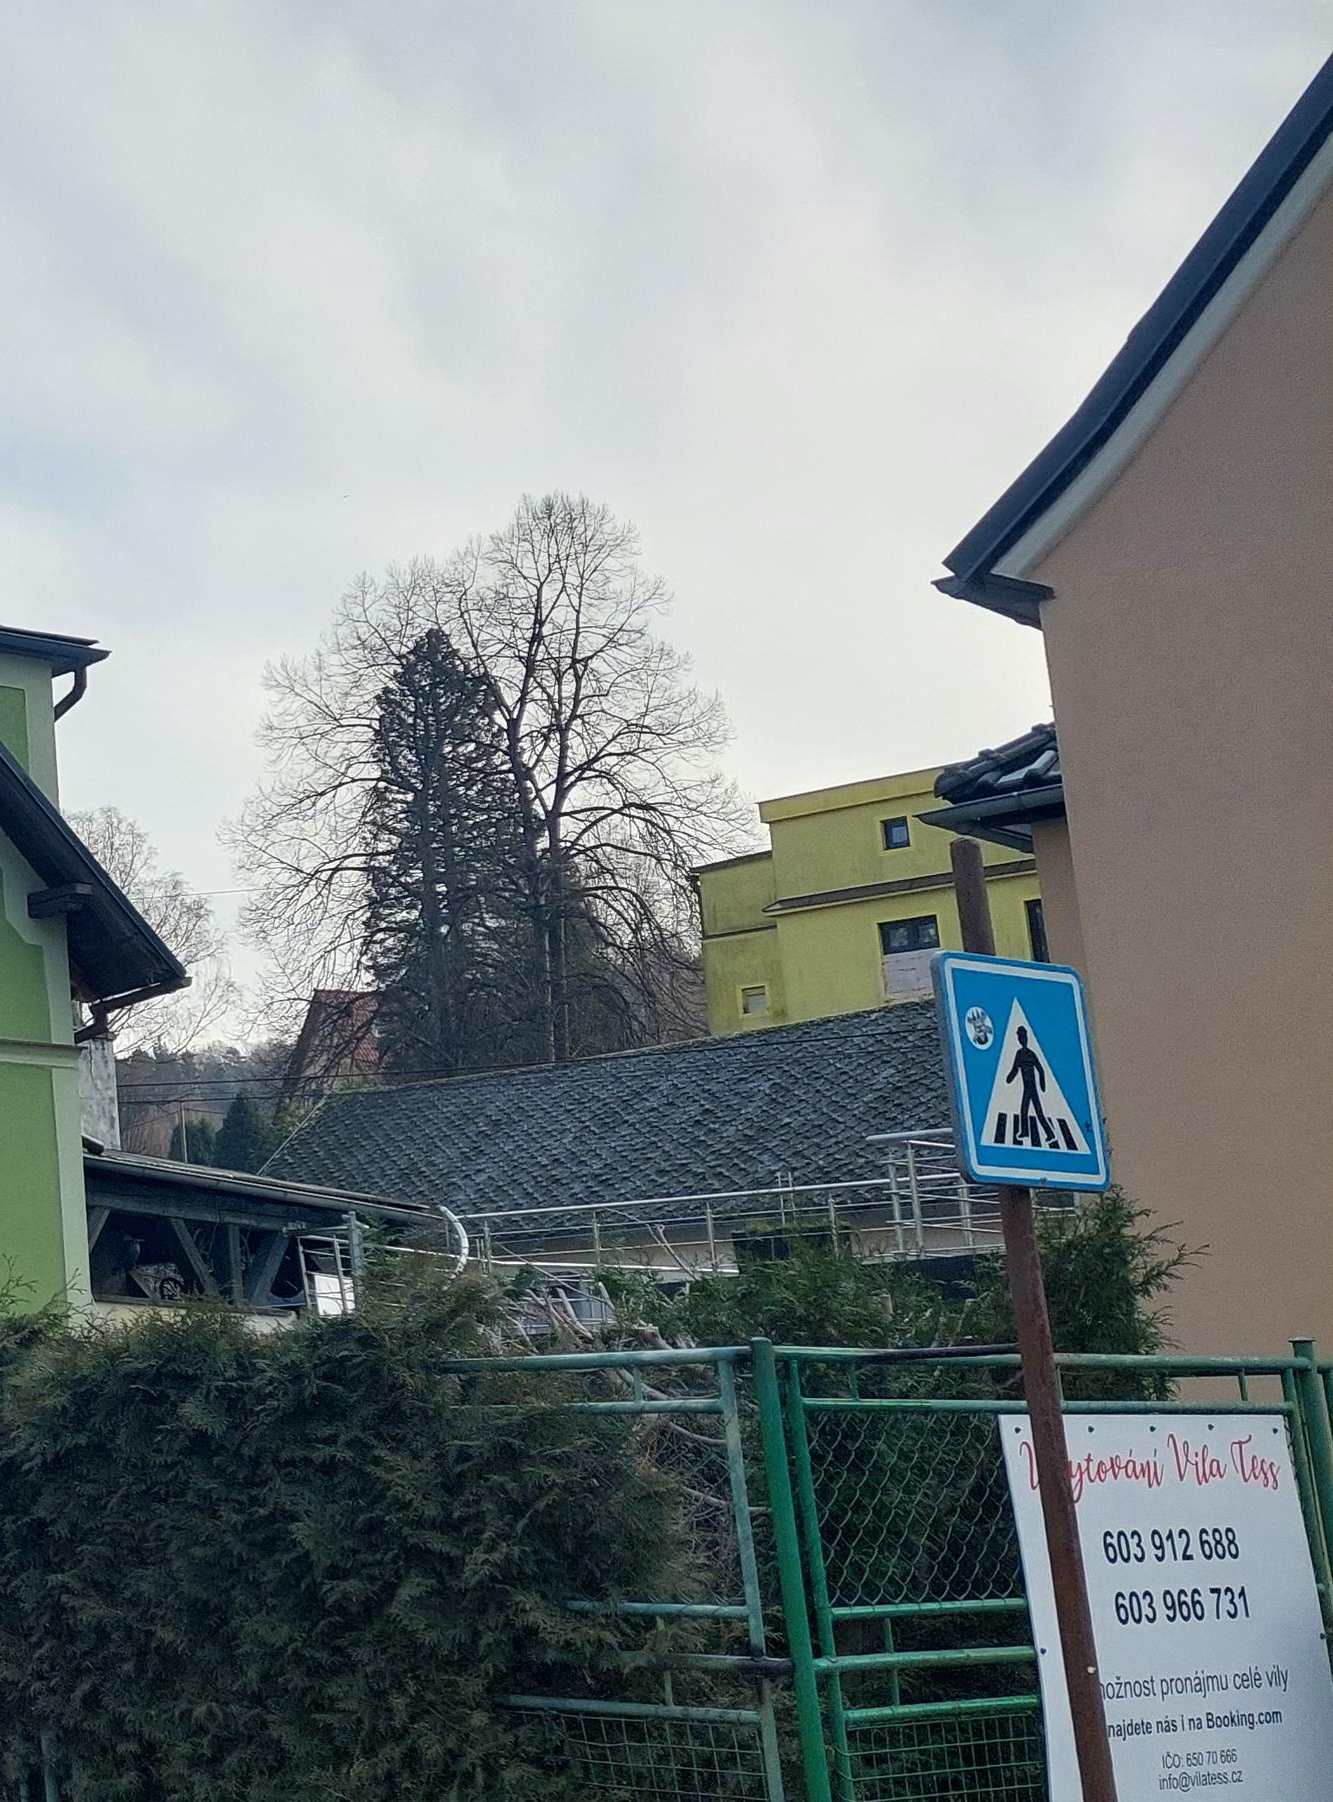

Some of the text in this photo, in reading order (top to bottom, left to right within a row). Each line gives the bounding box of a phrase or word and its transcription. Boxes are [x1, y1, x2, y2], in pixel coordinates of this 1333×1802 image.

[1167, 1433, 1227, 1486] Vila
[1231, 1434, 1280, 1490] Tess
[1103, 1527, 1240, 1564] 603 912 688
[1114, 1585, 1250, 1625] 603 966 731
[1160, 1670, 1229, 1702] pronájmu
[1233, 1666, 1263, 1690] celé
[1265, 1664, 1289, 1693] vily
[1108, 1717, 1153, 1742] najdete
[1156, 1715, 1178, 1734] nás
[1188, 1716, 1203, 1731] na
[1206, 1709, 1283, 1730] Booking.com
[1186, 1752, 1204, 1766] 650
[1207, 1751, 1218, 1765] 70
[1158, 1770, 1244, 1793] info@vilatess.cz
